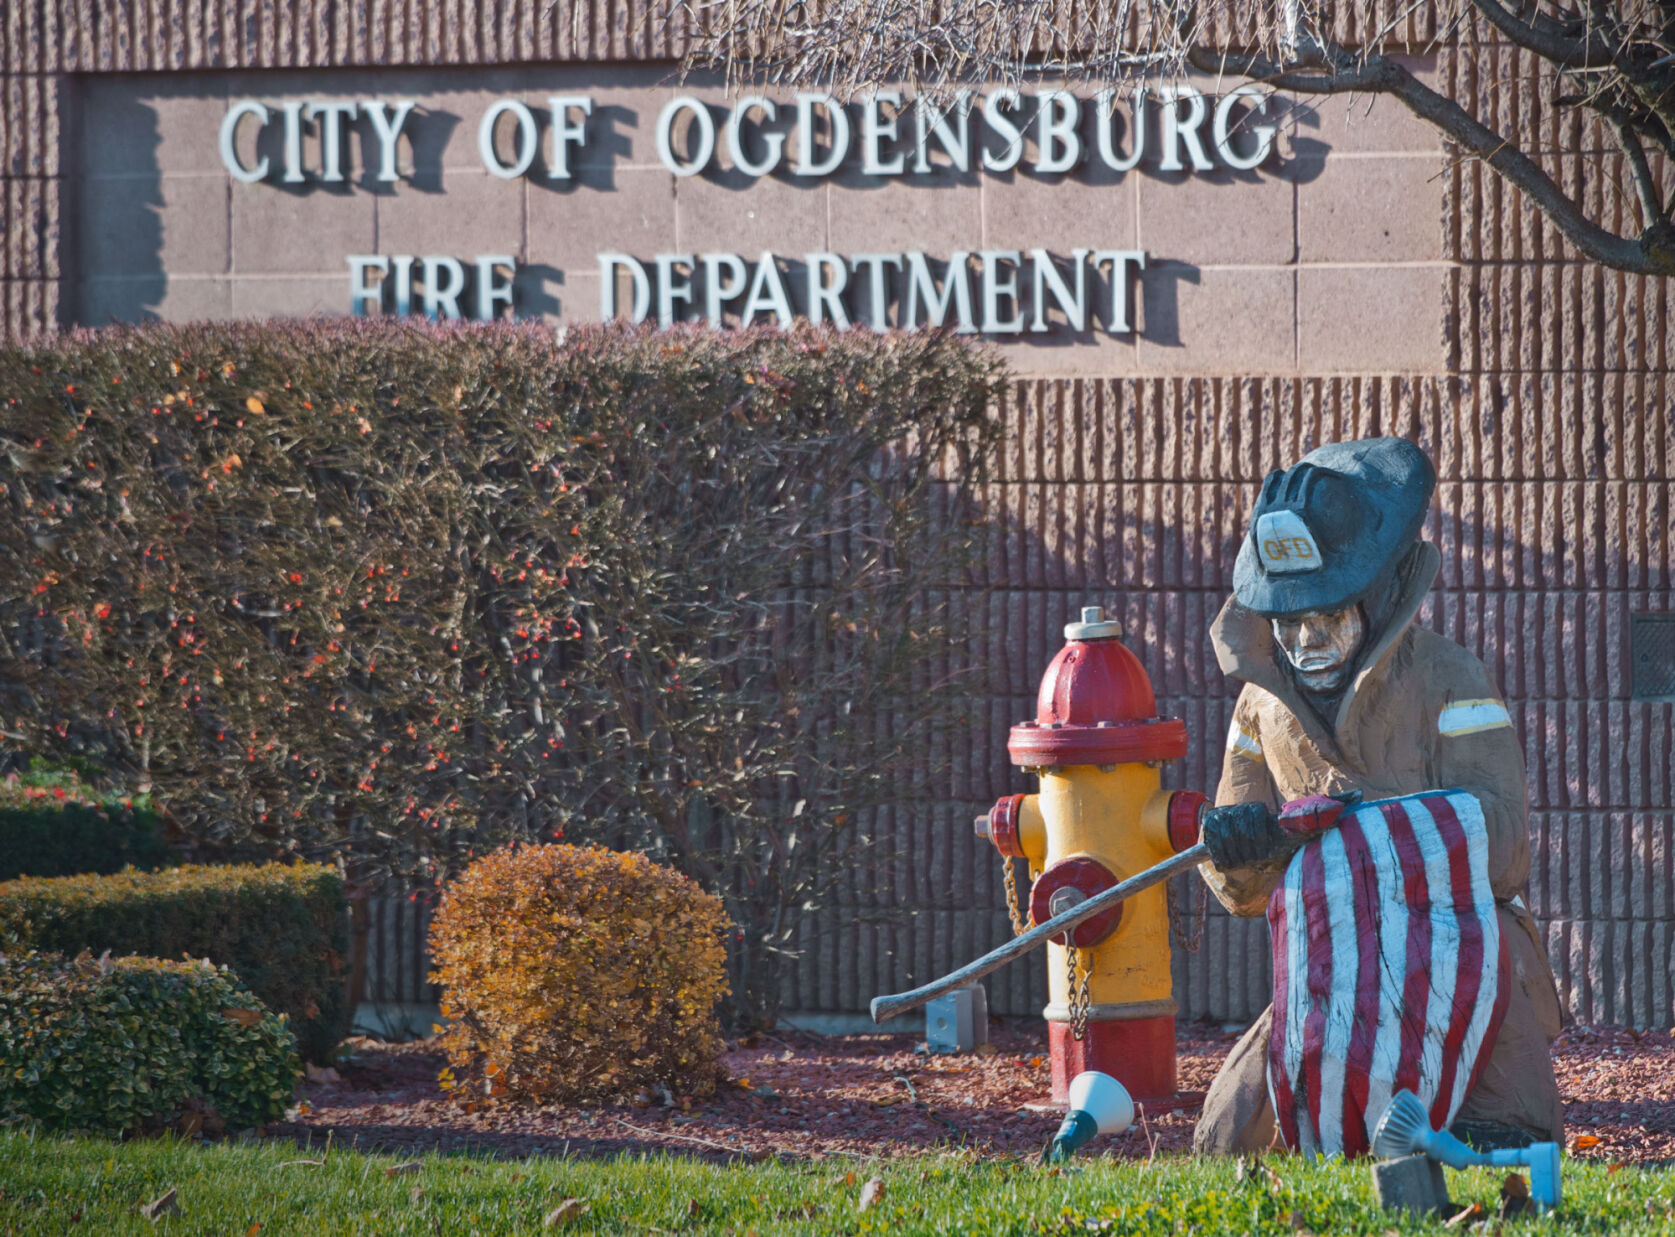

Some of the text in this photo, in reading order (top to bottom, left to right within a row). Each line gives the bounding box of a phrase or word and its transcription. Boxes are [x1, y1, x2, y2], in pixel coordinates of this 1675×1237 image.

[218, 86, 1275, 183] CITY OF OGDENSBURG
[346, 248, 1146, 335] FIRE DEPARTMENT
[1263, 537, 1314, 561] OFD
